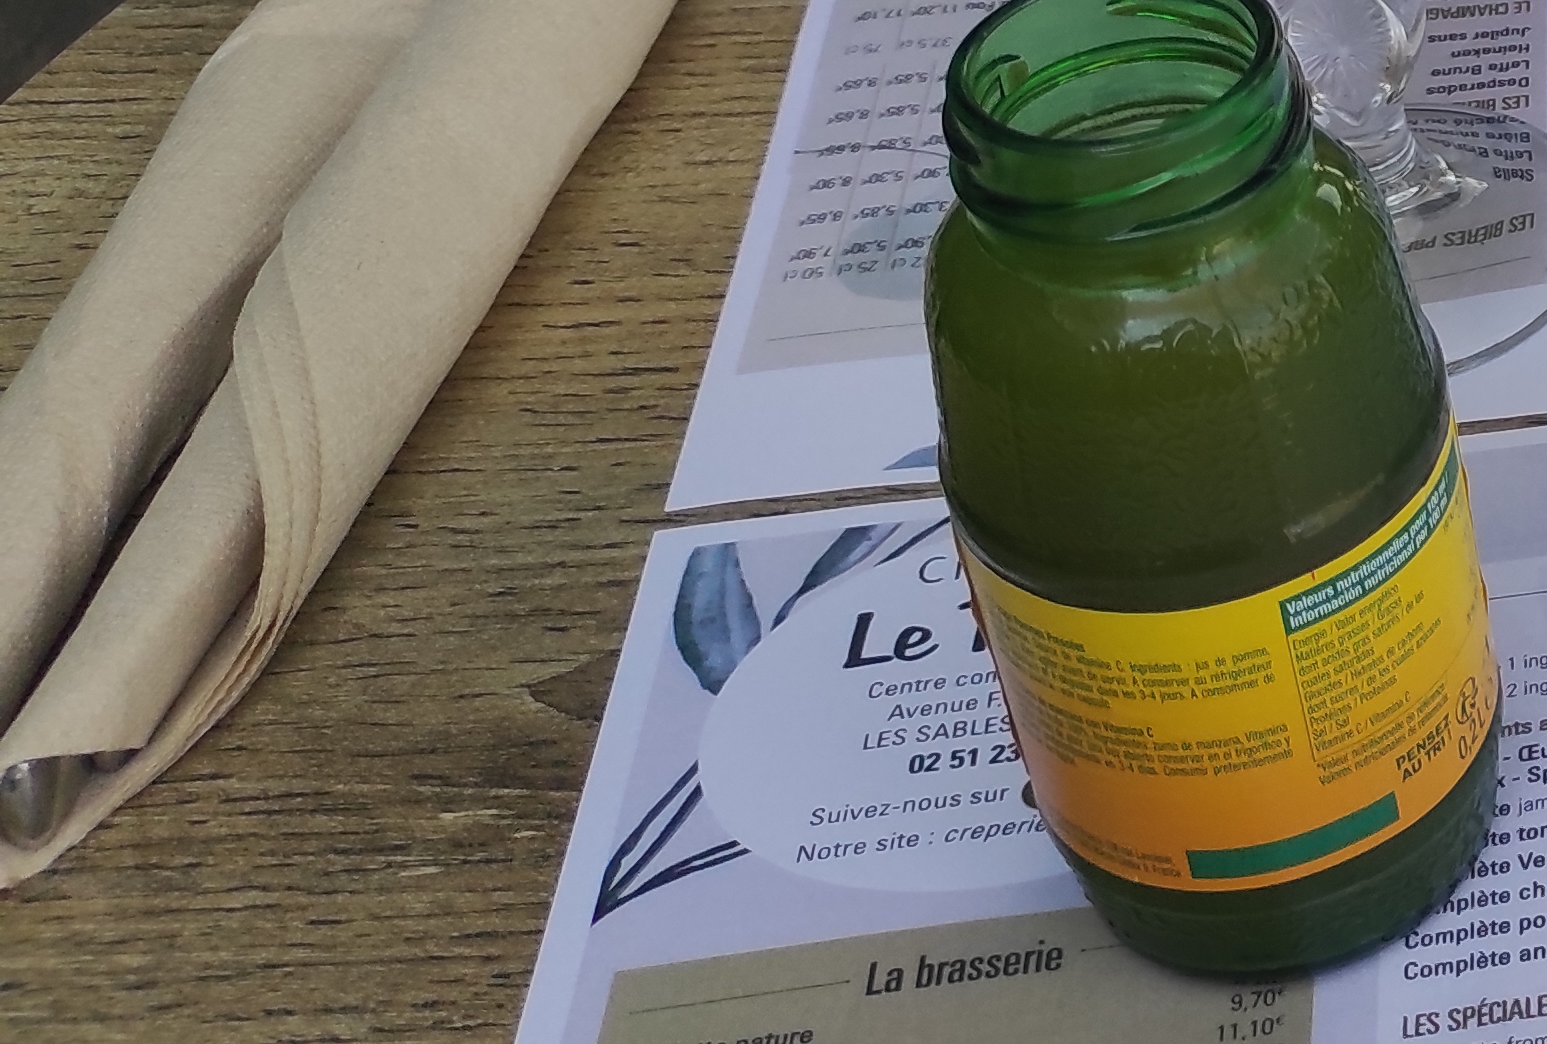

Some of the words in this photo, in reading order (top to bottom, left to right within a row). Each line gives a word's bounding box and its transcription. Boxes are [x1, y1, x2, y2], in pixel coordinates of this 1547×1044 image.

[1492, 166, 1535, 182] Stella
[1286, 584, 1340, 614] Valeurs
[1337, 534, 1409, 591] nutritionnelles
[842, 611, 940, 669] Le
[1508, 656, 1515, 671] 1
[1501, 682, 1518, 699] 2
[887, 697, 979, 722] Avenue
[908, 752, 942, 775] 02
[949, 747, 979, 770] 51
[988, 739, 1021, 765] 23
[1395, 713, 1452, 771] PENSEZ
[1402, 759, 1423, 783] AU
[1425, 738, 1447, 763] TRI
[809, 793, 962, 827] Suivez-nous
[969, 787, 1011, 805] sur
[796, 841, 867, 864] Notre
[875, 831, 920, 852] site
[1404, 919, 1511, 950] Complète
[865, 961, 904, 996] La
[914, 940, 1064, 988] brasserie
[1403, 950, 1511, 981] Complète
[1402, 1011, 1441, 1040] LES
